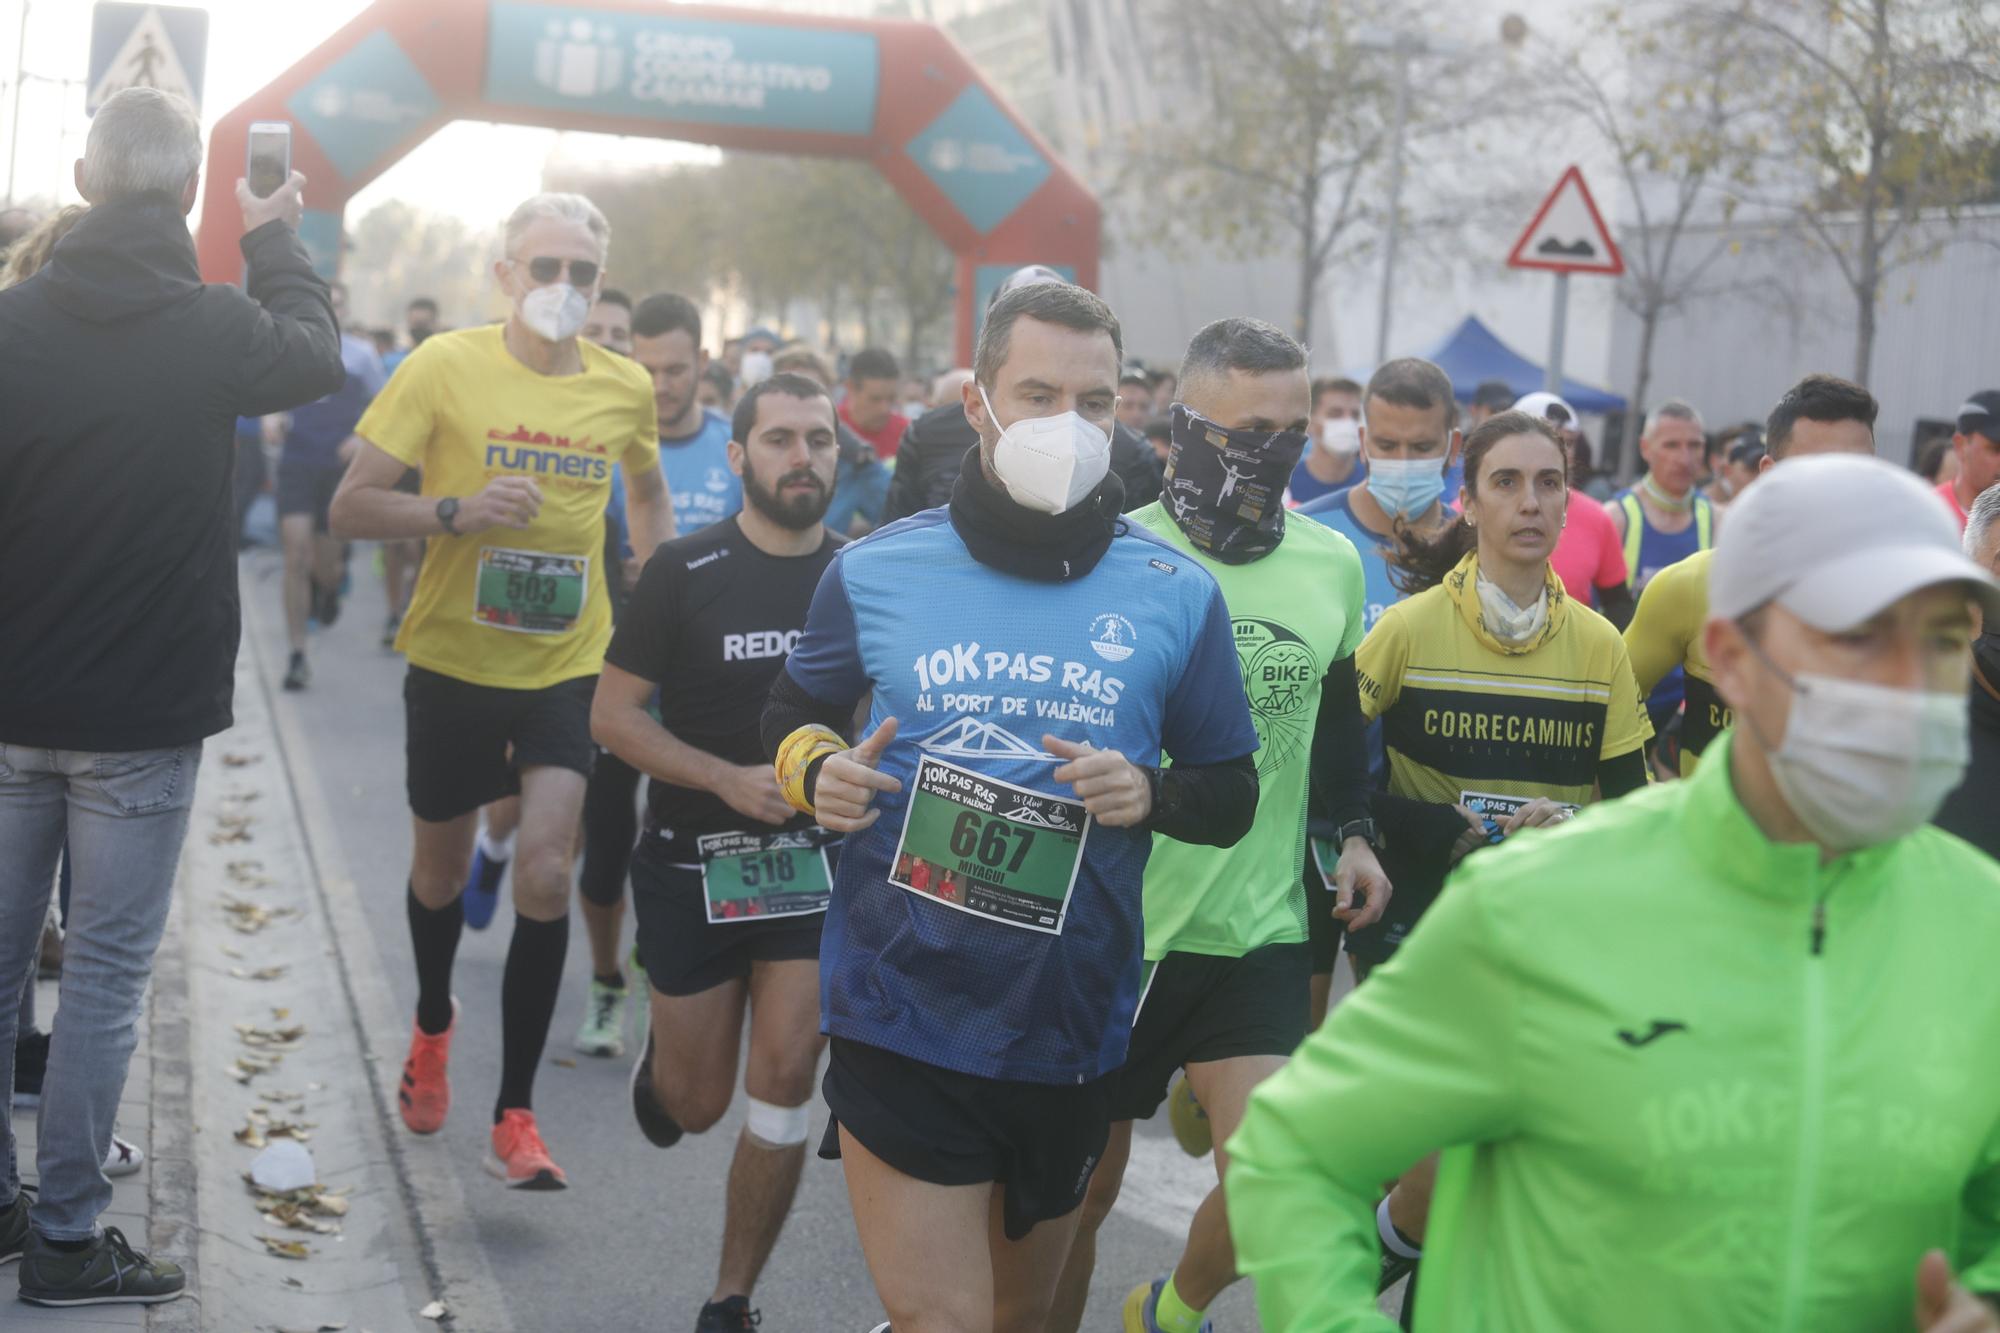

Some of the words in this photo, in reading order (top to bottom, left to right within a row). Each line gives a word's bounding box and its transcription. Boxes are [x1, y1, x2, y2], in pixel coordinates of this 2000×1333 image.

[485, 444, 607, 480] runners
[506, 572, 558, 605] 503
[914, 641, 982, 691] 10K
[984, 651, 1054, 683] PAS
[1061, 661, 1126, 706] RAS
[1262, 665, 1310, 682] BIKE
[916, 694, 935, 712] AL
[942, 693, 994, 713] PORT
[1001, 696, 1028, 715] DE
[1035, 696, 1115, 727] VALÈNCIA
[1424, 709, 1595, 748] CORRECAMINOS
[922, 767, 951, 785] 10K
[949, 773, 974, 790] PAS
[973, 783, 998, 805] RAS
[931, 784, 950, 798] PORT
[951, 791, 961, 802] DE
[1486, 800, 1506, 812] PAS
[949, 810, 1037, 873] 667
[739, 850, 797, 887] 518
[958, 859, 1006, 885] MIYAGUI
